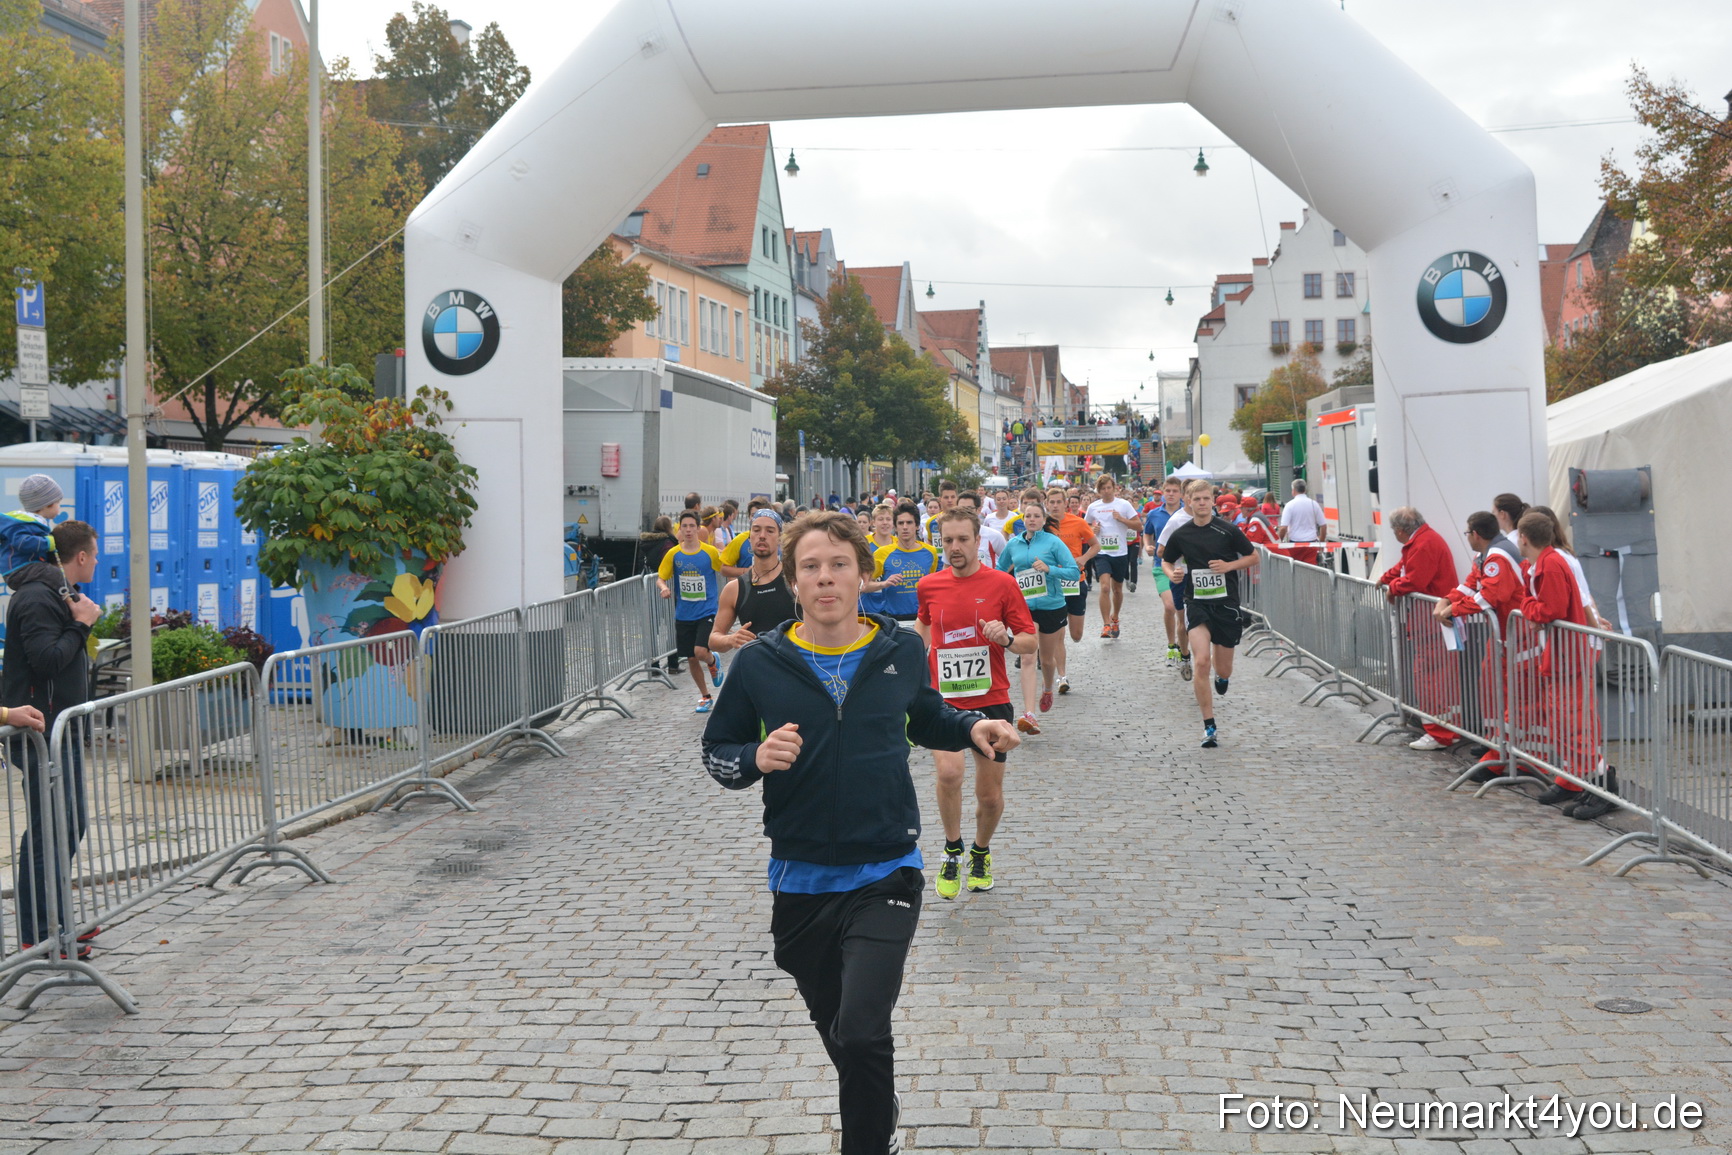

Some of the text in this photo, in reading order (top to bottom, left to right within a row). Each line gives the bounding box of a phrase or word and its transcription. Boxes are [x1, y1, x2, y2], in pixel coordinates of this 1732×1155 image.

[1424, 253, 1500, 285] BMW
[427, 291, 493, 319] BMW
[1066, 444, 1098, 453] START
[105, 486, 123, 513] DIXI
[151, 486, 168, 511] DIXI
[200, 486, 219, 511] DIXI
[1101, 537, 1118, 545] 5164
[681, 581, 703, 592] 5518
[1018, 574, 1043, 589] 5079
[1195, 574, 1223, 588] 5045
[943, 658, 986, 679] 5172
[952, 681, 978, 690] Manuel
